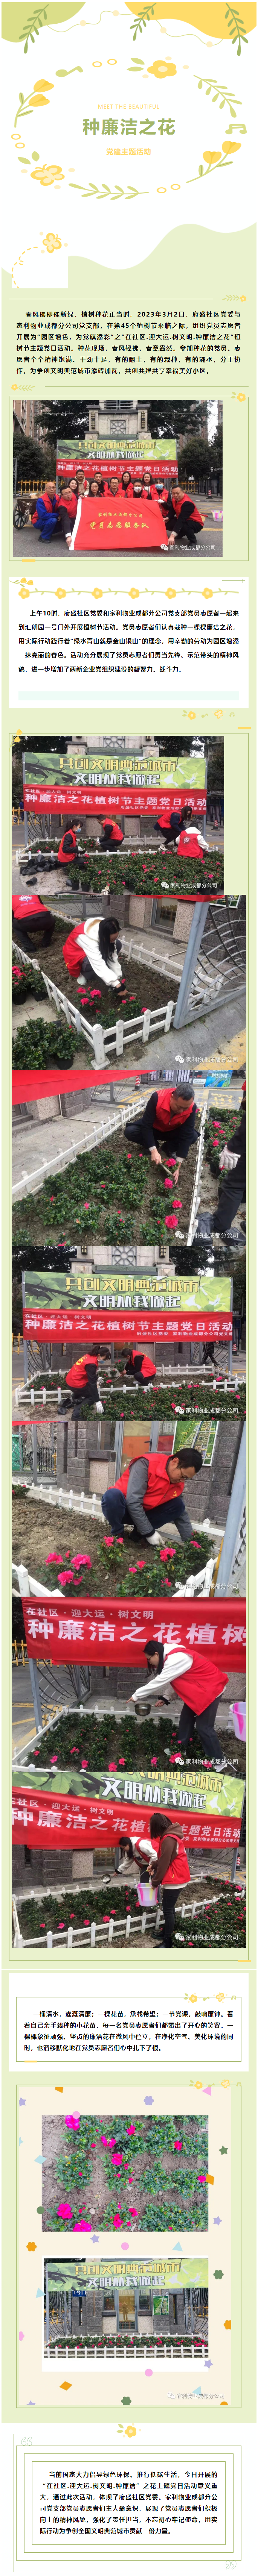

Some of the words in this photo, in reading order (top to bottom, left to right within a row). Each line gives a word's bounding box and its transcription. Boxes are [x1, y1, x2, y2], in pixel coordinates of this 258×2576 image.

[82, 118, 176, 135] 种廉洁之花
[59, 758, 176, 771] 共创文明典范城市
[73, 773, 160, 785] 文明从我做起
[25, 793, 206, 806] 种廉洁之花植树节主题党日活动
[66, 1277, 198, 1292] 共创文明典范城市
[82, 1295, 181, 1308] 文明从我做起
[25, 1319, 233, 1331] 种廉洁之花植树节主题党日活动
[101, 1776, 207, 1809] 文明从我做起
[75, 2262, 180, 2275] 共创文明典范城市
[86, 2276, 165, 2287] 文明从我做起
